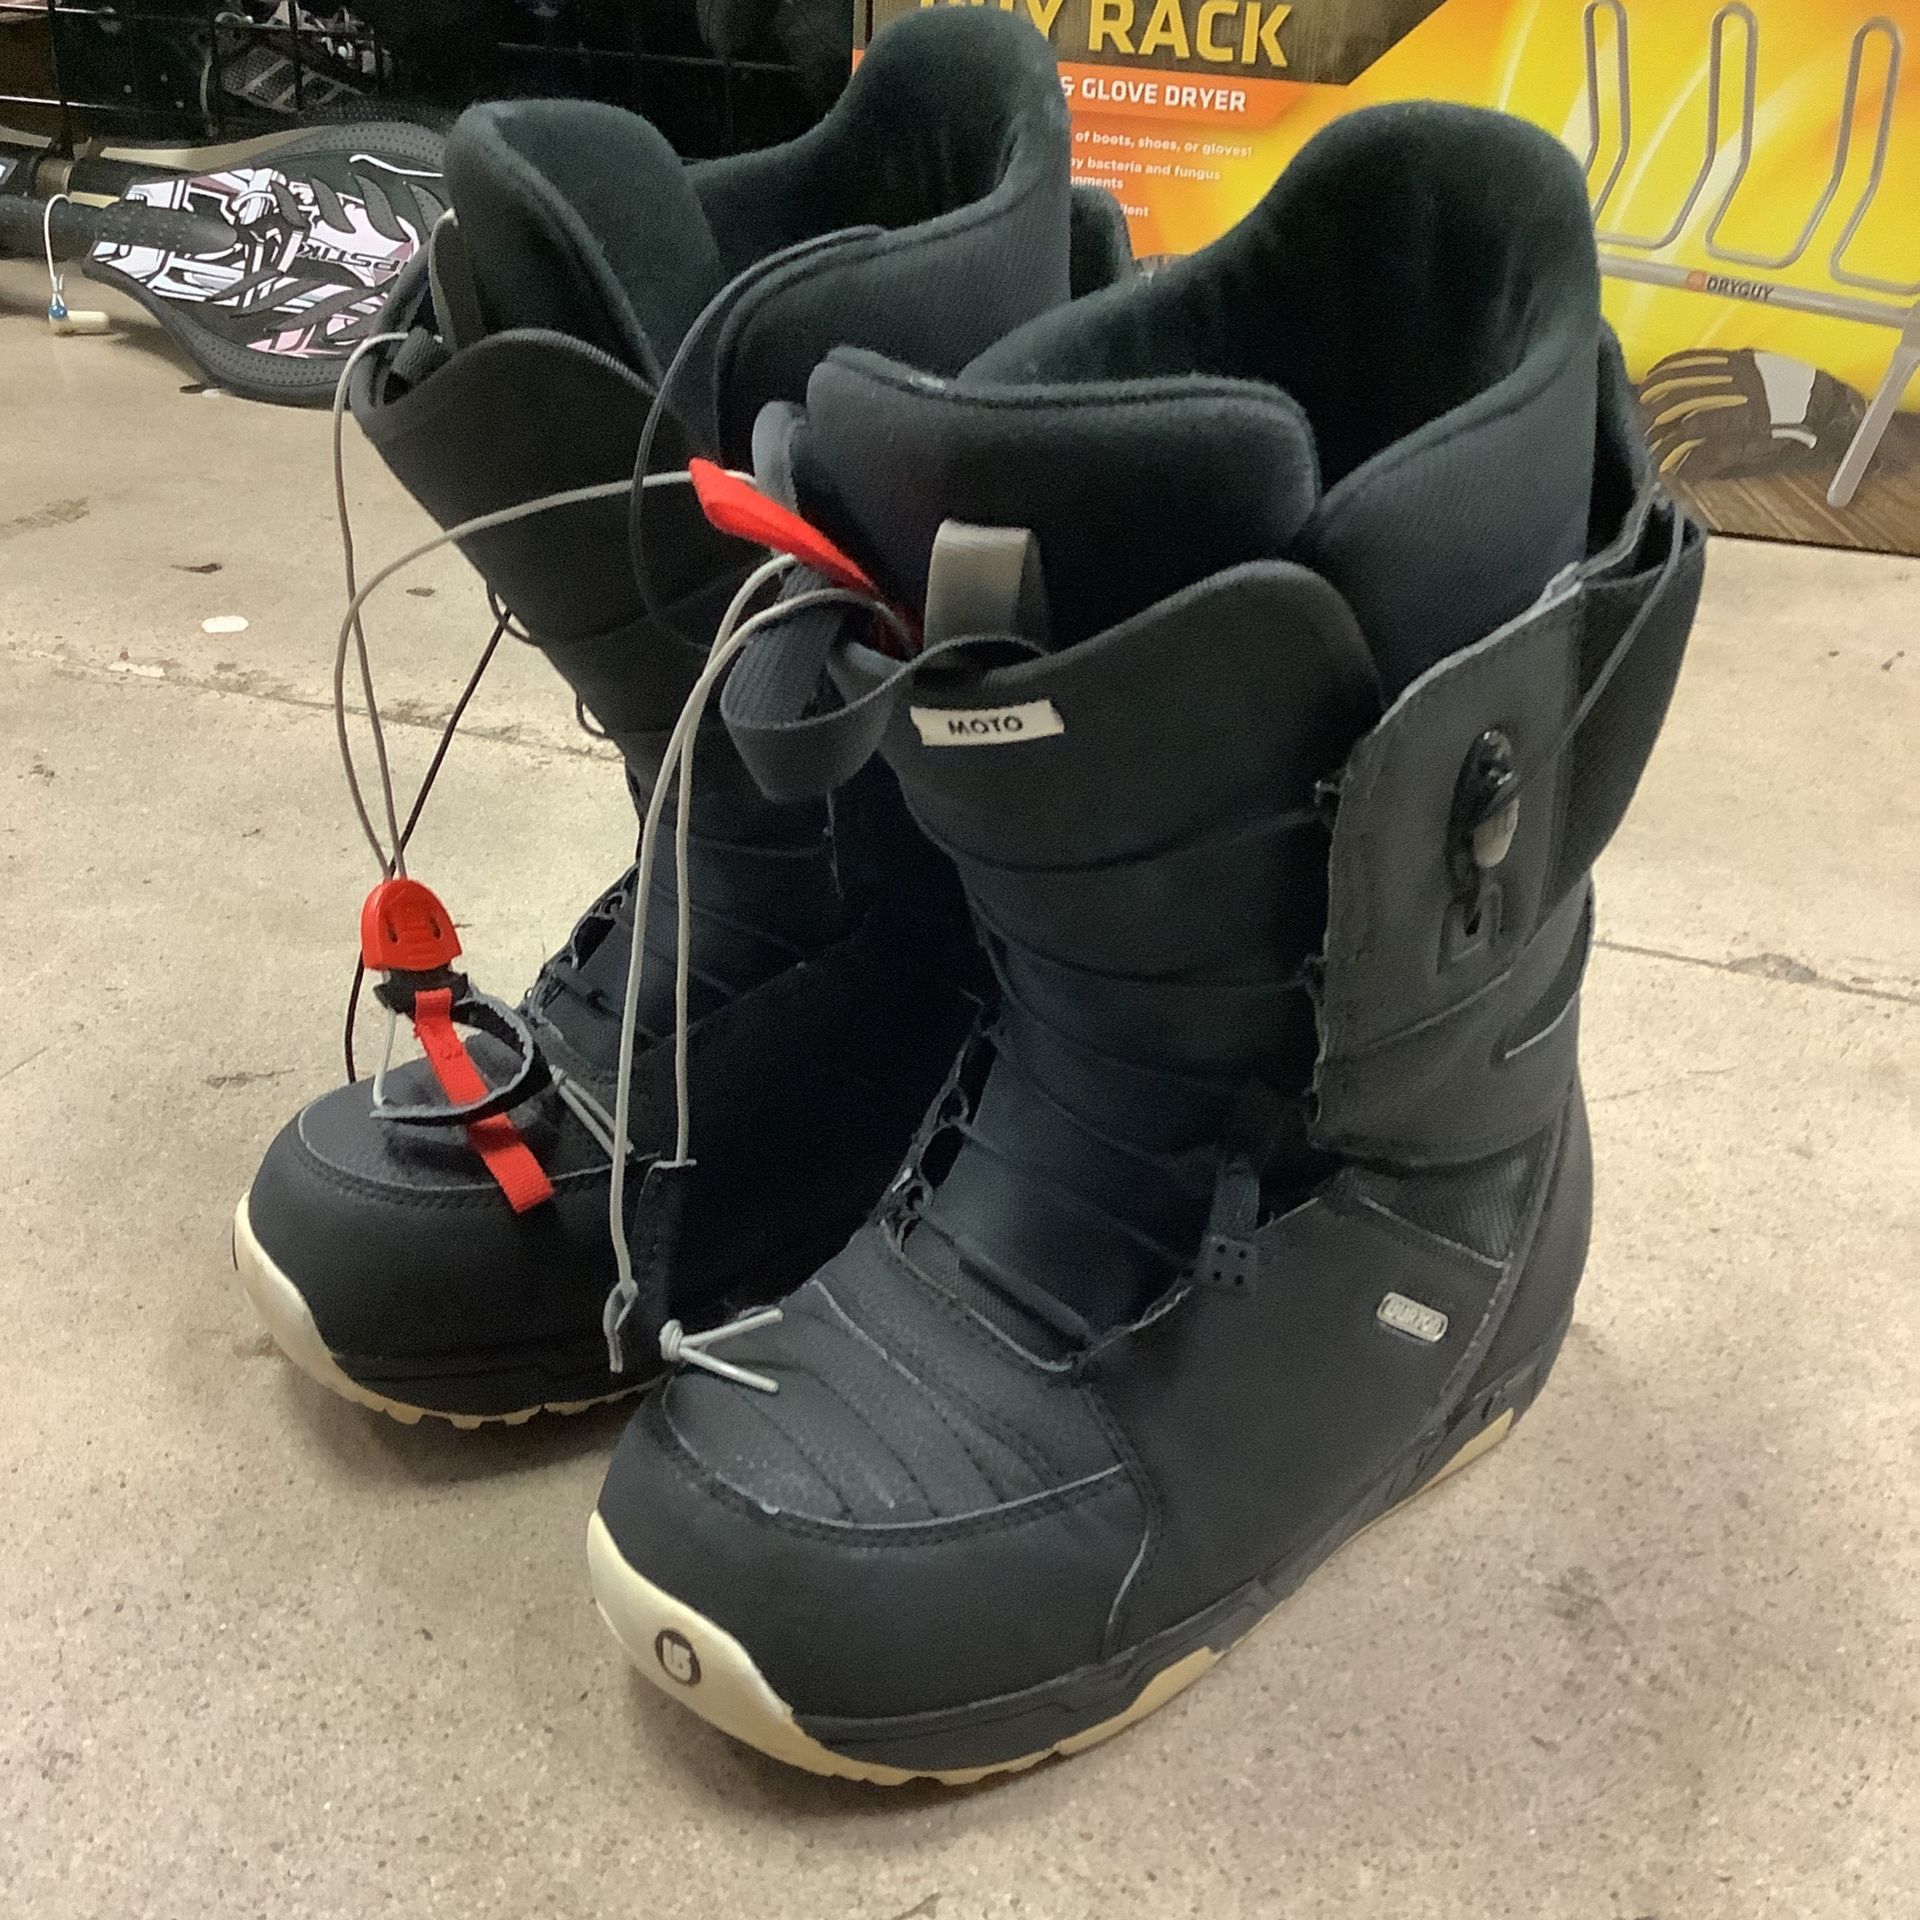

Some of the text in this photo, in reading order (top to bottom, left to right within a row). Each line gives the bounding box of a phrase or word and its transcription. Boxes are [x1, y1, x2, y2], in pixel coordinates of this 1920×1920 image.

[1088, 0, 1293, 67] RACK
[1082, 78, 1158, 104] GLOVE
[1165, 85, 1246, 112] DRYER
[1075, 131, 1090, 142] of
[1093, 131, 1135, 147] boots,
[1138, 136, 1181, 152] shoes,
[1184, 142, 1199, 152] or
[1087, 157, 1142, 173] bacteria
[1146, 164, 1171, 176] and
[1175, 166, 1221, 181] fungus
[1120, 204, 1150, 217] lent
[1706, 276, 1775, 301] DRYGUY
[947, 715, 1024, 735] MOTO
